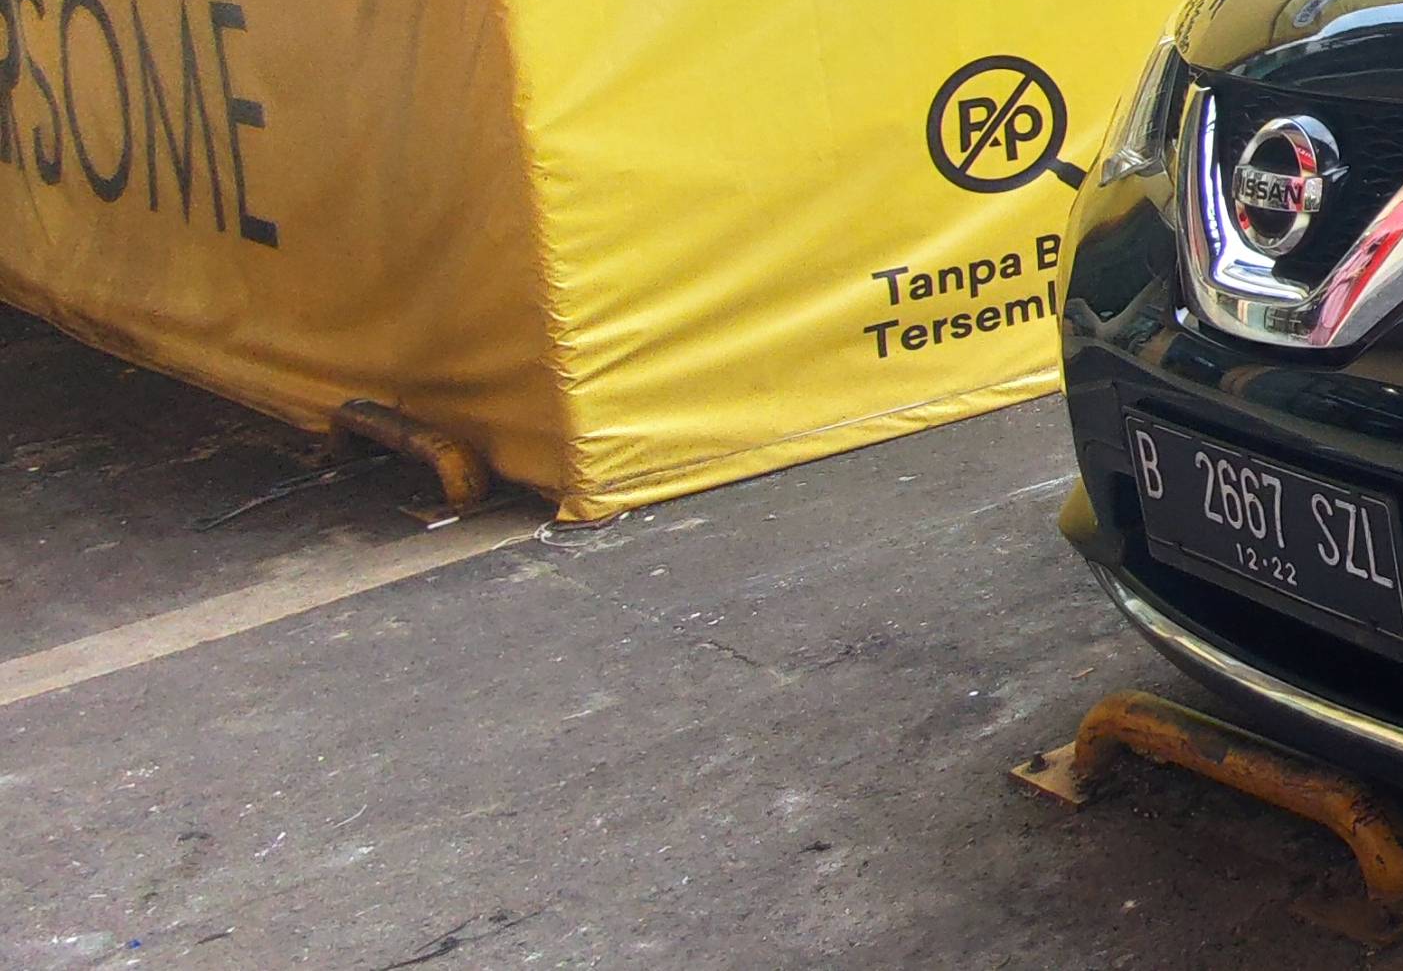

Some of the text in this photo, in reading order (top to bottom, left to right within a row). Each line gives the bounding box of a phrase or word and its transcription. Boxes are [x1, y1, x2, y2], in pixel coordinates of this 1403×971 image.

[871, 250, 1022, 307] Tanpa
[1135, 429, 1394, 589] B 2667 SZL
